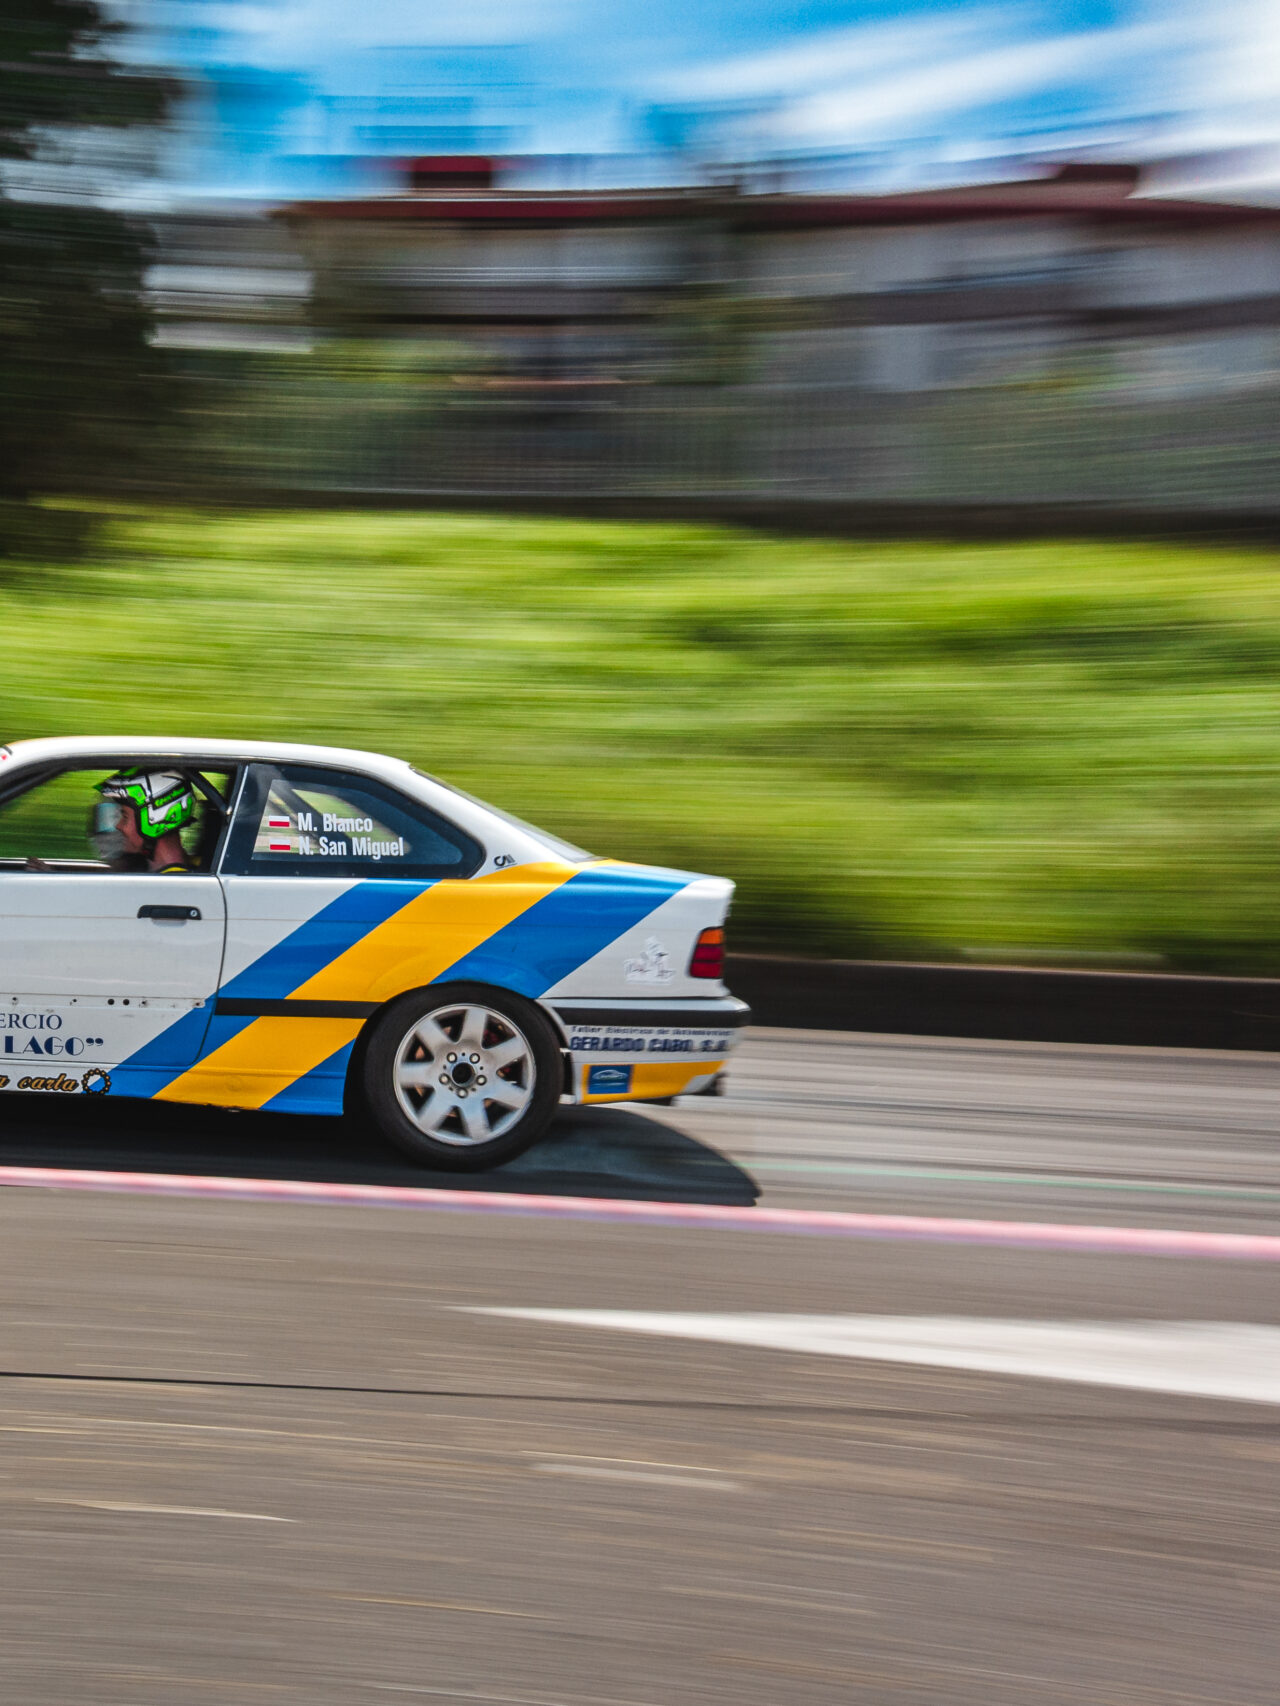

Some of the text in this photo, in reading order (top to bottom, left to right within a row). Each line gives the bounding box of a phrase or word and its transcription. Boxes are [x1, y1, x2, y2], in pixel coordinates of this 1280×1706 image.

[297, 812, 373, 833] M. Blanco
[298, 836, 404, 861] N. San Miguel
[570, 1036, 645, 1052] GERARDO
[17, 1073, 79, 1092] carta
